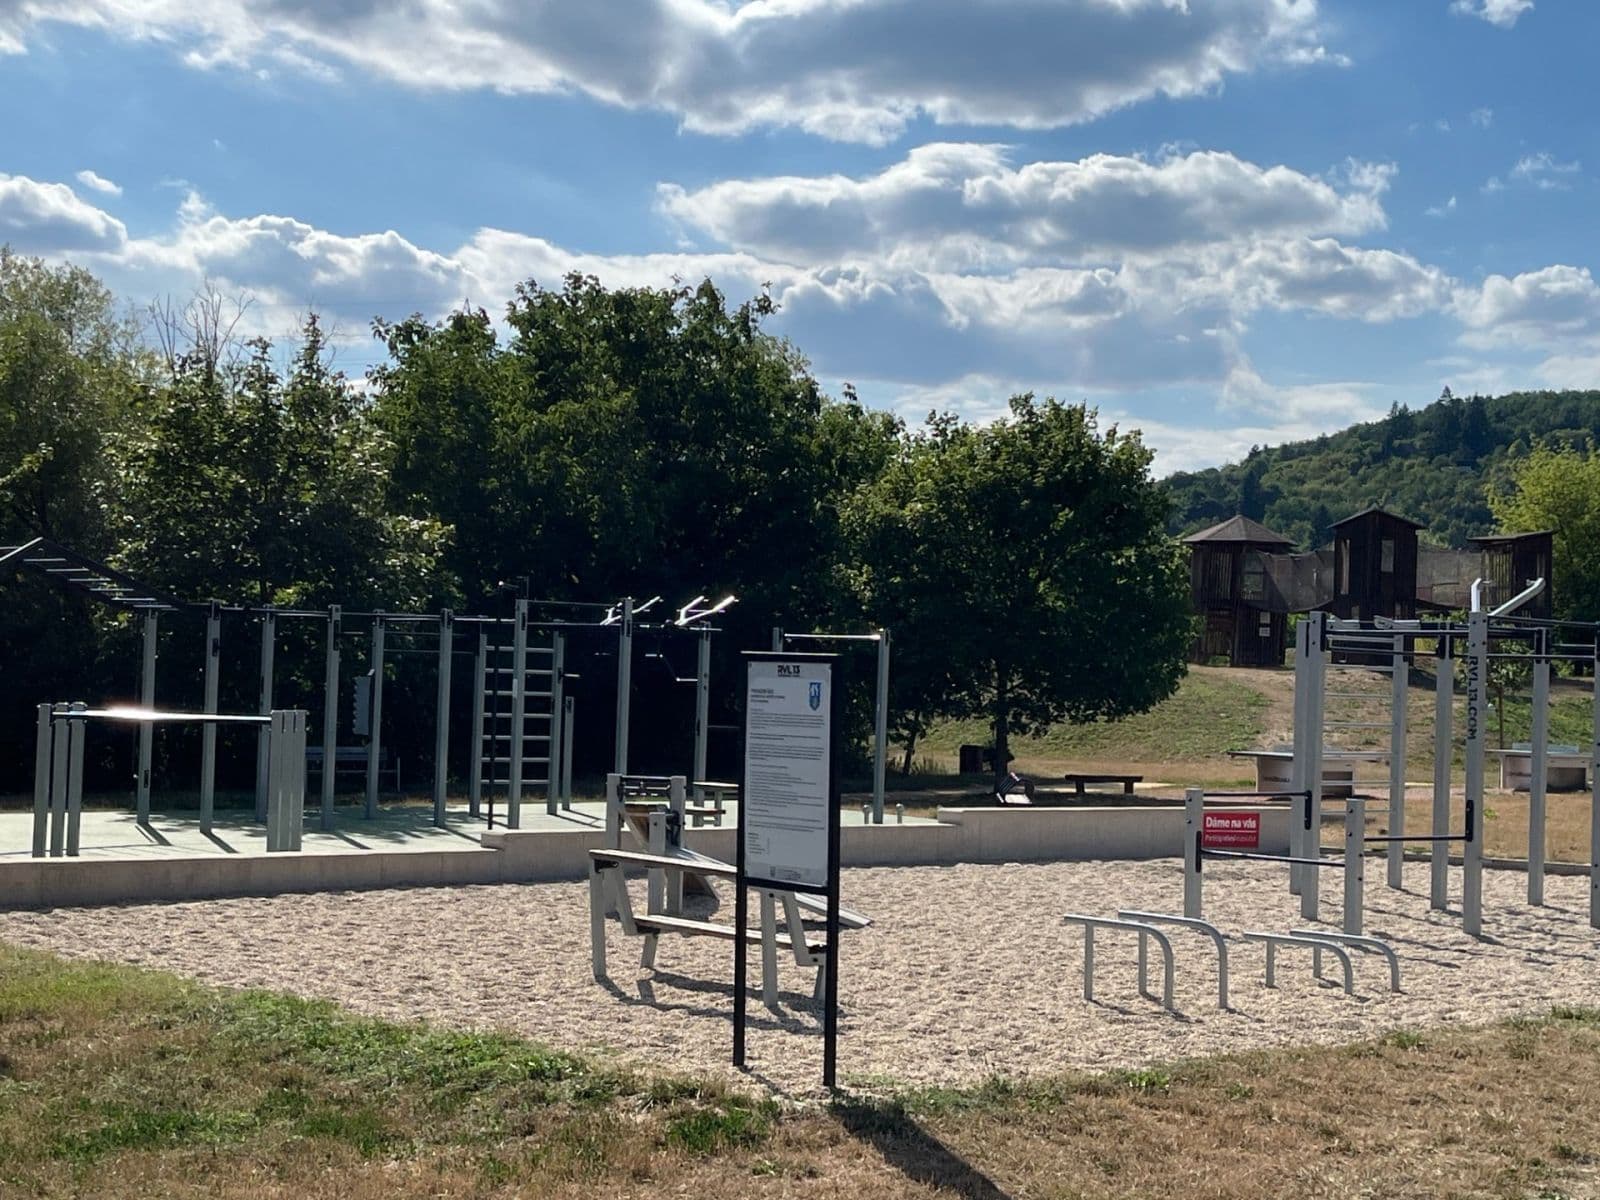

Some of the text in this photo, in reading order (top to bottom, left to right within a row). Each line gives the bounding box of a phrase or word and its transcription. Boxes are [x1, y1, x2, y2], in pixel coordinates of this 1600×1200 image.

[1467, 656, 1479, 740] RVL13.COM
[1205, 816, 1230, 829] Dáme
[1231, 819, 1242, 829] na
